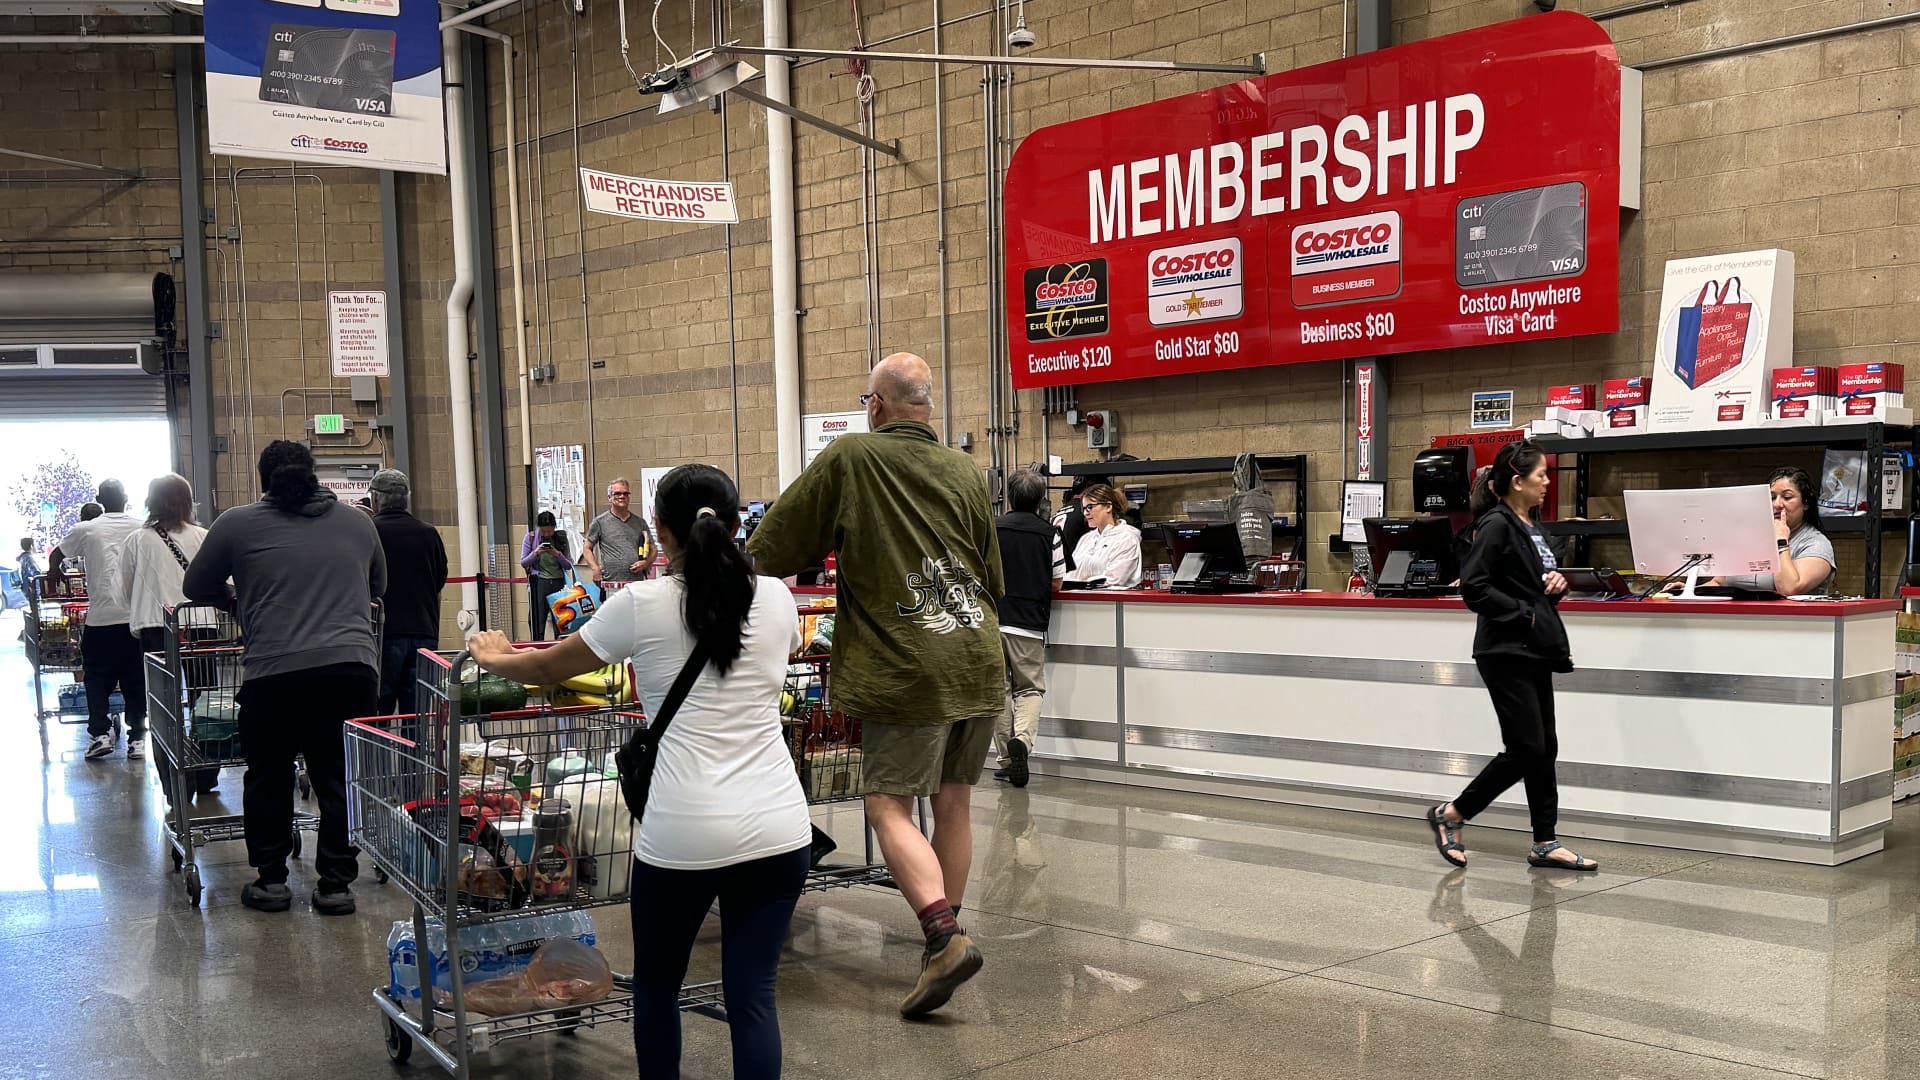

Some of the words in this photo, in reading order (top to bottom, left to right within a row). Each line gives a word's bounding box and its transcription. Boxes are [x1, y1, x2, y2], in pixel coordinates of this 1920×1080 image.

[275, 31, 293, 43] citi
[270, 70, 286, 78] 4100
[287, 71, 302, 80] 3901
[303, 74, 321, 83] 2345
[323, 77, 343, 86] 6789
[353, 97, 386, 113] VISA
[272, 109, 295, 119] Costco
[296, 111, 328, 122] Anywhere
[346, 118, 363, 126] Card
[363, 119, 371, 128] by
[291, 135, 311, 148] citi
[324, 138, 368, 149] COSTCO
[1088, 91, 1485, 245] MEMBERSHIP
[589, 174, 727, 202] MERCHANDISE
[615, 197, 706, 219] RETURNS
[1463, 203, 1483, 220] citi
[1295, 223, 1392, 255] COSTCO
[1324, 244, 1390, 262] WHOLESALE
[1463, 252, 1480, 260] 4100
[1481, 249, 1498, 258] 3901
[1498, 247, 1517, 256] 2345
[1518, 243, 1538, 253] 6789
[1152, 248, 1235, 277] COSTCO
[1550, 257, 1580, 272] VISA
[1667, 267, 1683, 276] Give
[1685, 265, 1697, 274] the
[1698, 264, 1713, 273] Gift
[1713, 262, 1722, 271] of
[1722, 258, 1773, 271] Membership
[1176, 268, 1232, 284] WHOLESALE
[1036, 278, 1097, 299] COSTCO
[1312, 282, 1345, 294] BUSINESS
[1345, 278, 1375, 290] MEMBER
[332, 295, 352, 304] Thank
[353, 295, 365, 304] You
[1055, 293, 1095, 305] WHOLESALE
[1165, 304, 1182, 313] GOLD
[1182, 303, 1197, 311] STAR
[1198, 299, 1223, 309] MEMBER
[1459, 292, 1507, 315] Costco
[1509, 284, 1581, 313] Anywhere
[1701, 304, 1726, 315] Bakery
[1072, 315, 1105, 325] MEMBER
[1300, 319, 1363, 345] Business
[1365, 311, 1395, 341] $60
[1521, 308, 1555, 333] Card
[1698, 322, 1733, 338] Appliances
[1716, 331, 1738, 343] Optical
[1155, 337, 1183, 361] Gold
[1185, 335, 1212, 358] Star
[1214, 330, 1240, 358] $60
[1028, 350, 1080, 374] Executive
[1081, 345, 1112, 371] $120
[1695, 352, 1722, 367] Furniture
[1776, 380, 1815, 390] Membership
[1841, 377, 1882, 386] Membership
[1550, 398, 1582, 406] Membership
[1606, 391, 1641, 400] Membership
[319, 415, 339, 432] EXIT
[822, 420, 848, 429] COSTCO
[1447, 438, 1464, 446] BAG
[1466, 437, 1474, 445] &
[1478, 435, 1496, 444] TAG
[320, 481, 355, 490] MERGENCY
[357, 481, 370, 490] EXIT
